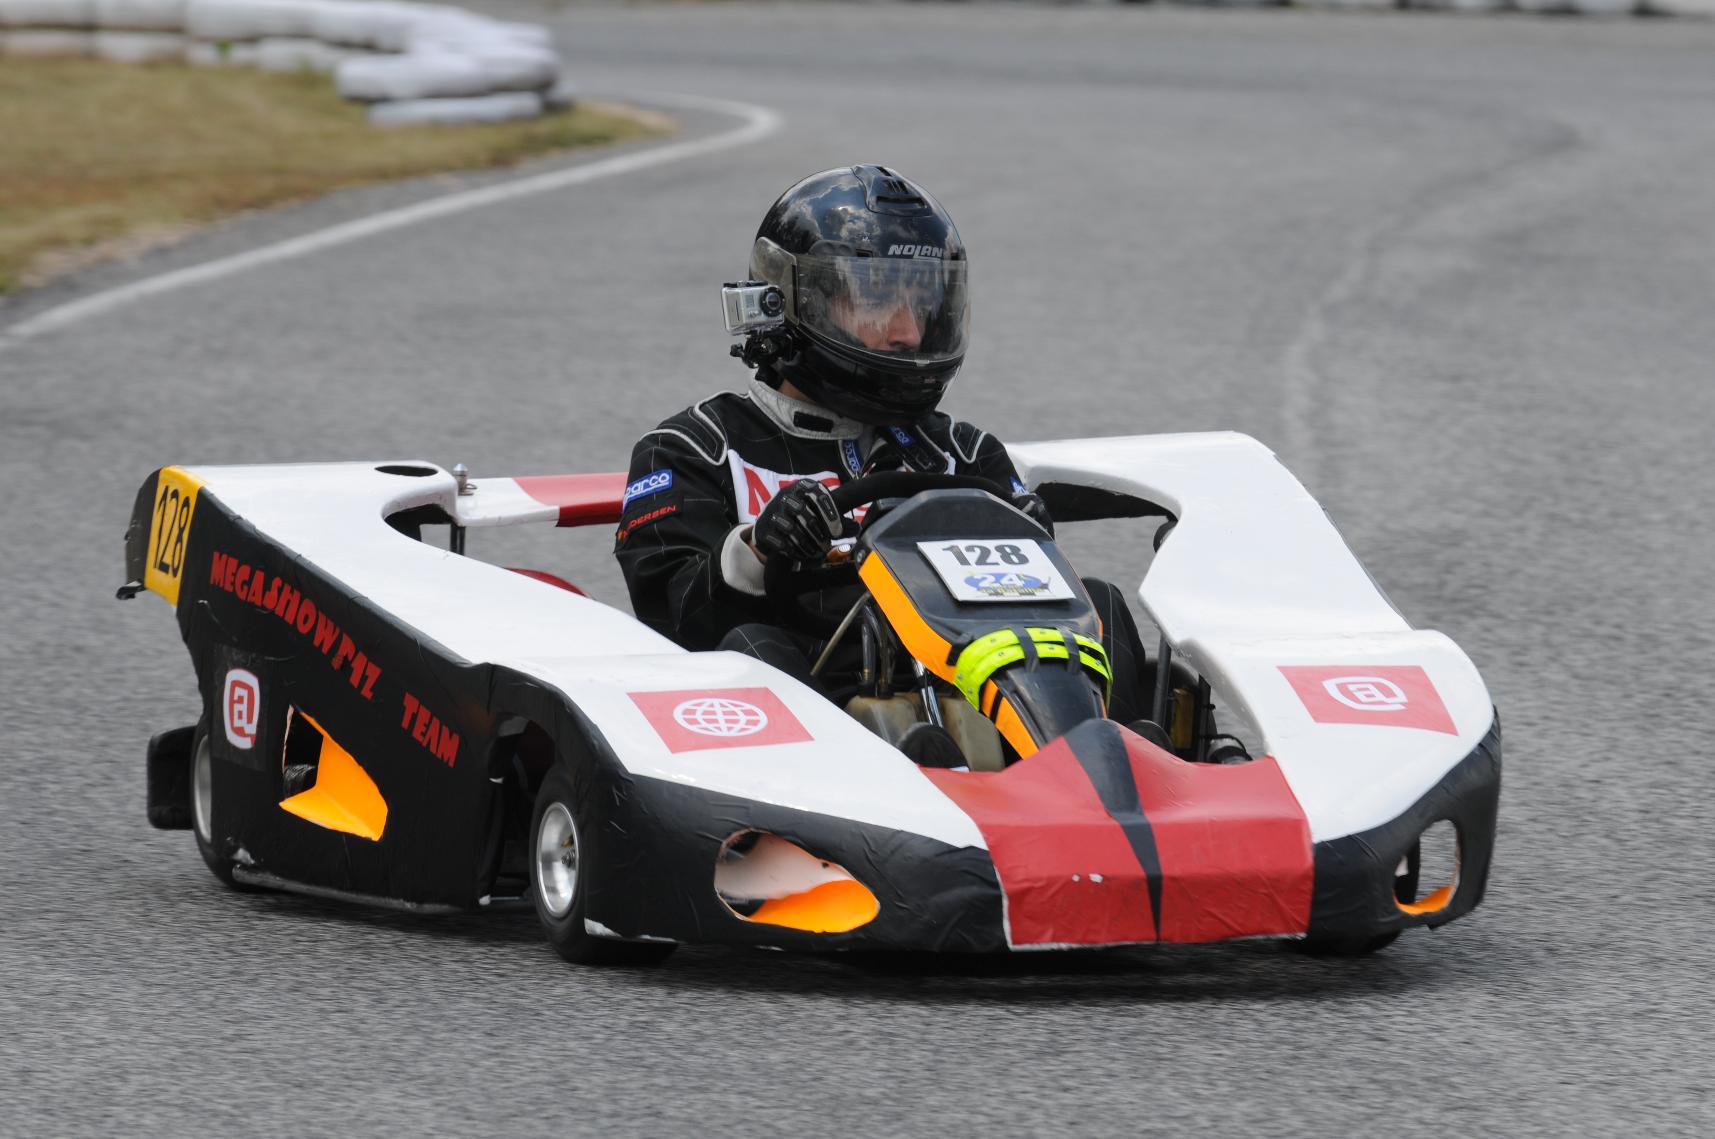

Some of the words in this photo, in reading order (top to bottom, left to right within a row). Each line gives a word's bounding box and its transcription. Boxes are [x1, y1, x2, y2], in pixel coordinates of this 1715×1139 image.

[888, 244, 943, 261] NOLAN
[623, 473, 670, 510] parco
[153, 485, 190, 578] 128
[942, 544, 1029, 566] 128
[401, 691, 460, 768] TEAM
